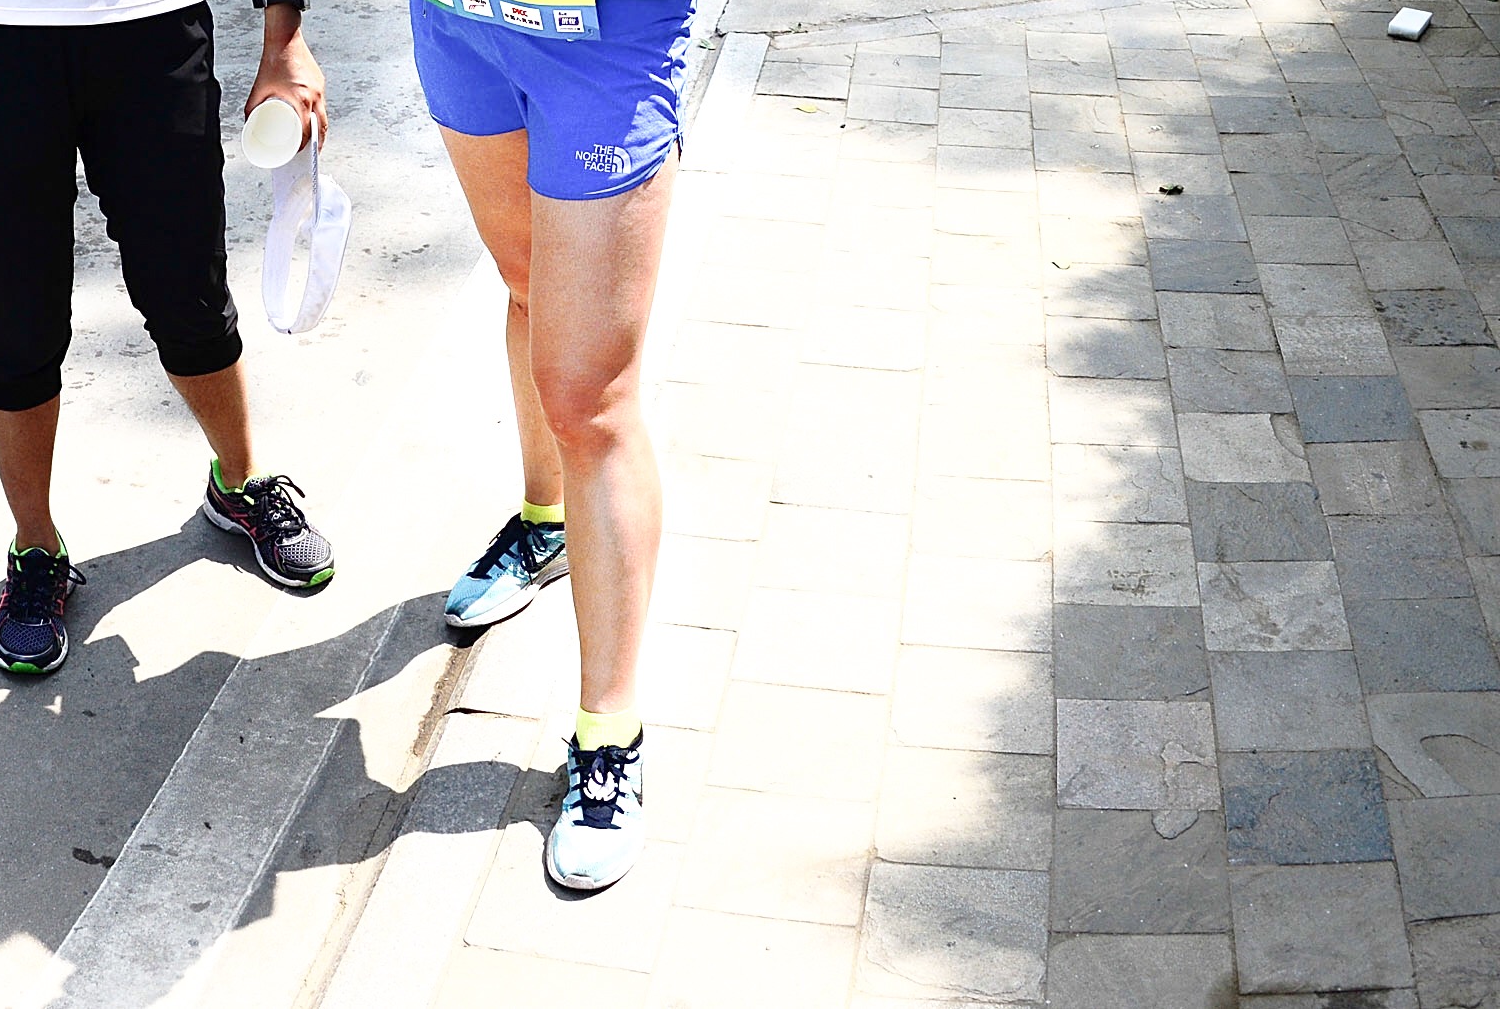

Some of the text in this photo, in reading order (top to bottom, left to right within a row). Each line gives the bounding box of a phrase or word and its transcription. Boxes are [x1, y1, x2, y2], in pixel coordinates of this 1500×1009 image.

[593, 143, 614, 155] THE
[575, 150, 613, 163] NORTH
[584, 161, 612, 173] FACE
